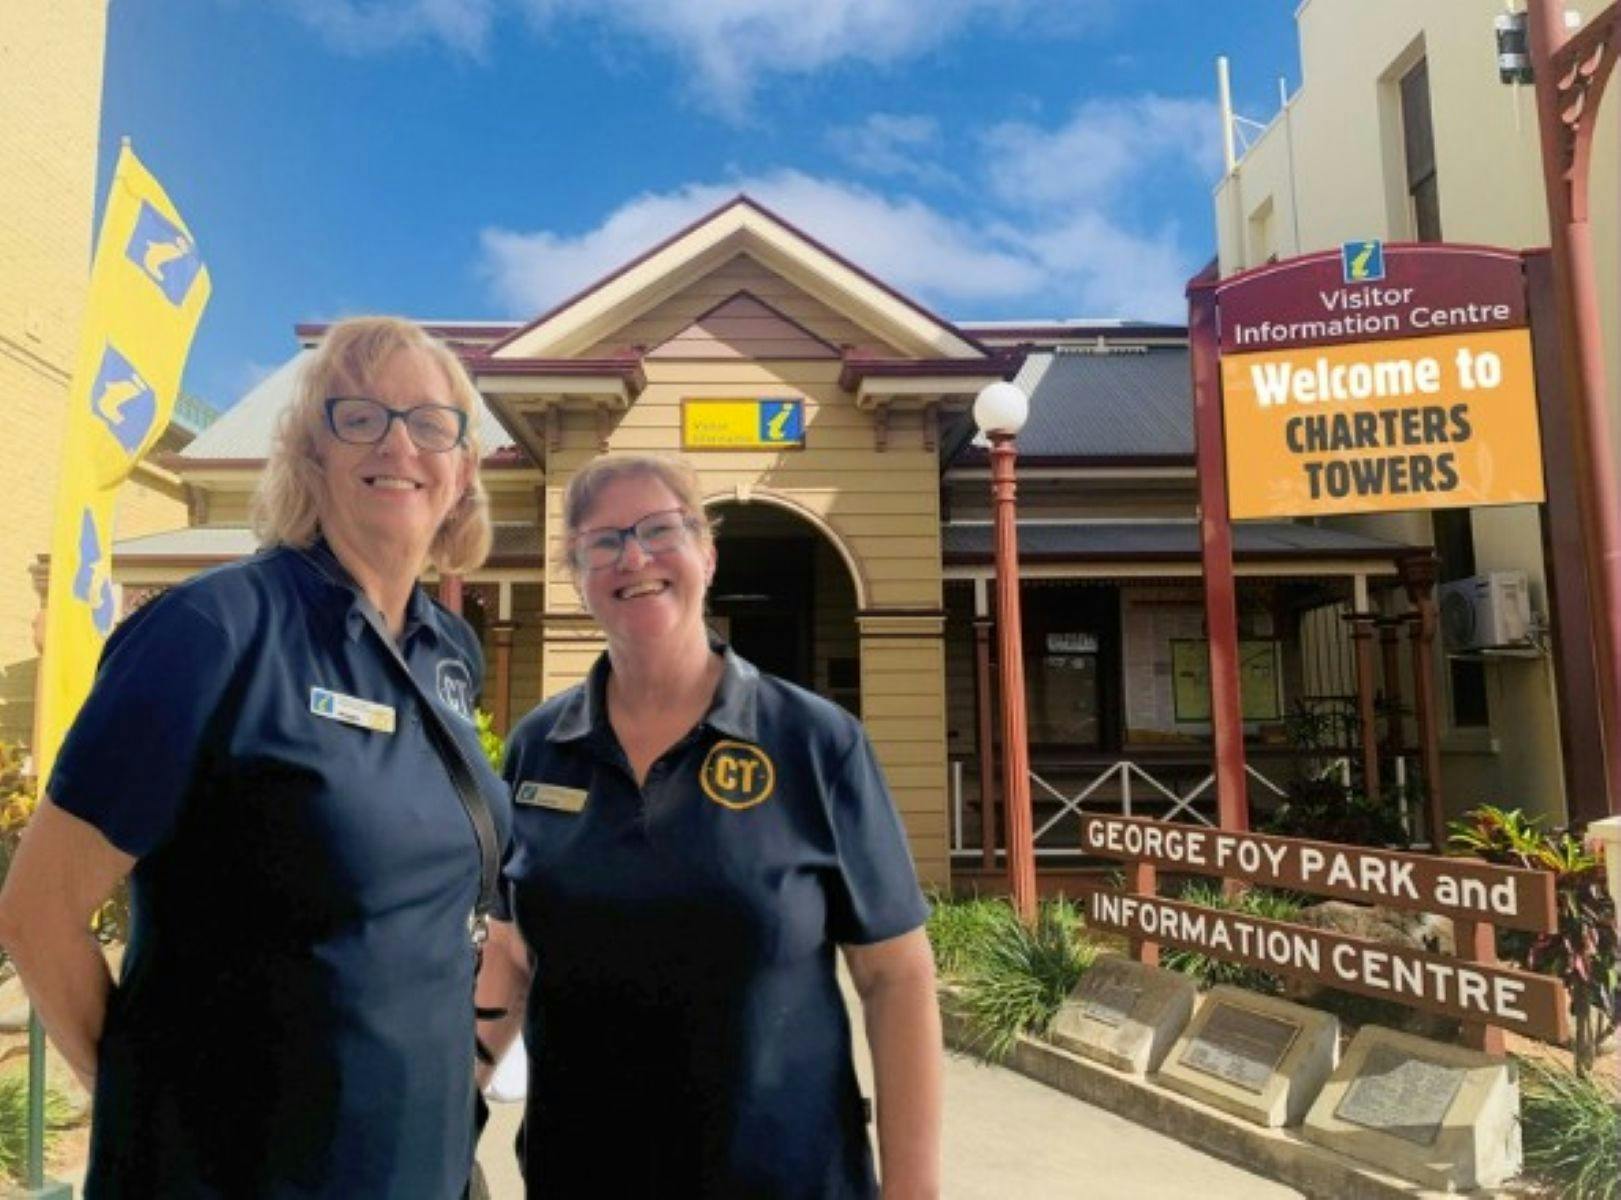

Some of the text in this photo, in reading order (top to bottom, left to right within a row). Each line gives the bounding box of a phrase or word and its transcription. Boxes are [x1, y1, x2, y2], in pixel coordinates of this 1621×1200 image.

[1320, 287, 1414, 311] Visitor
[1235, 303, 1511, 345] Information Centre
[1250, 348, 1501, 408] Welcome to
[1286, 403, 1472, 454] CHARTERS
[1303, 453, 1459, 500] TOWERS
[714, 755, 760, 793] CT
[1088, 819, 1518, 915] GEORGE FOY PARK and
[1092, 893, 1528, 1022] INFORMATION CENTRE
